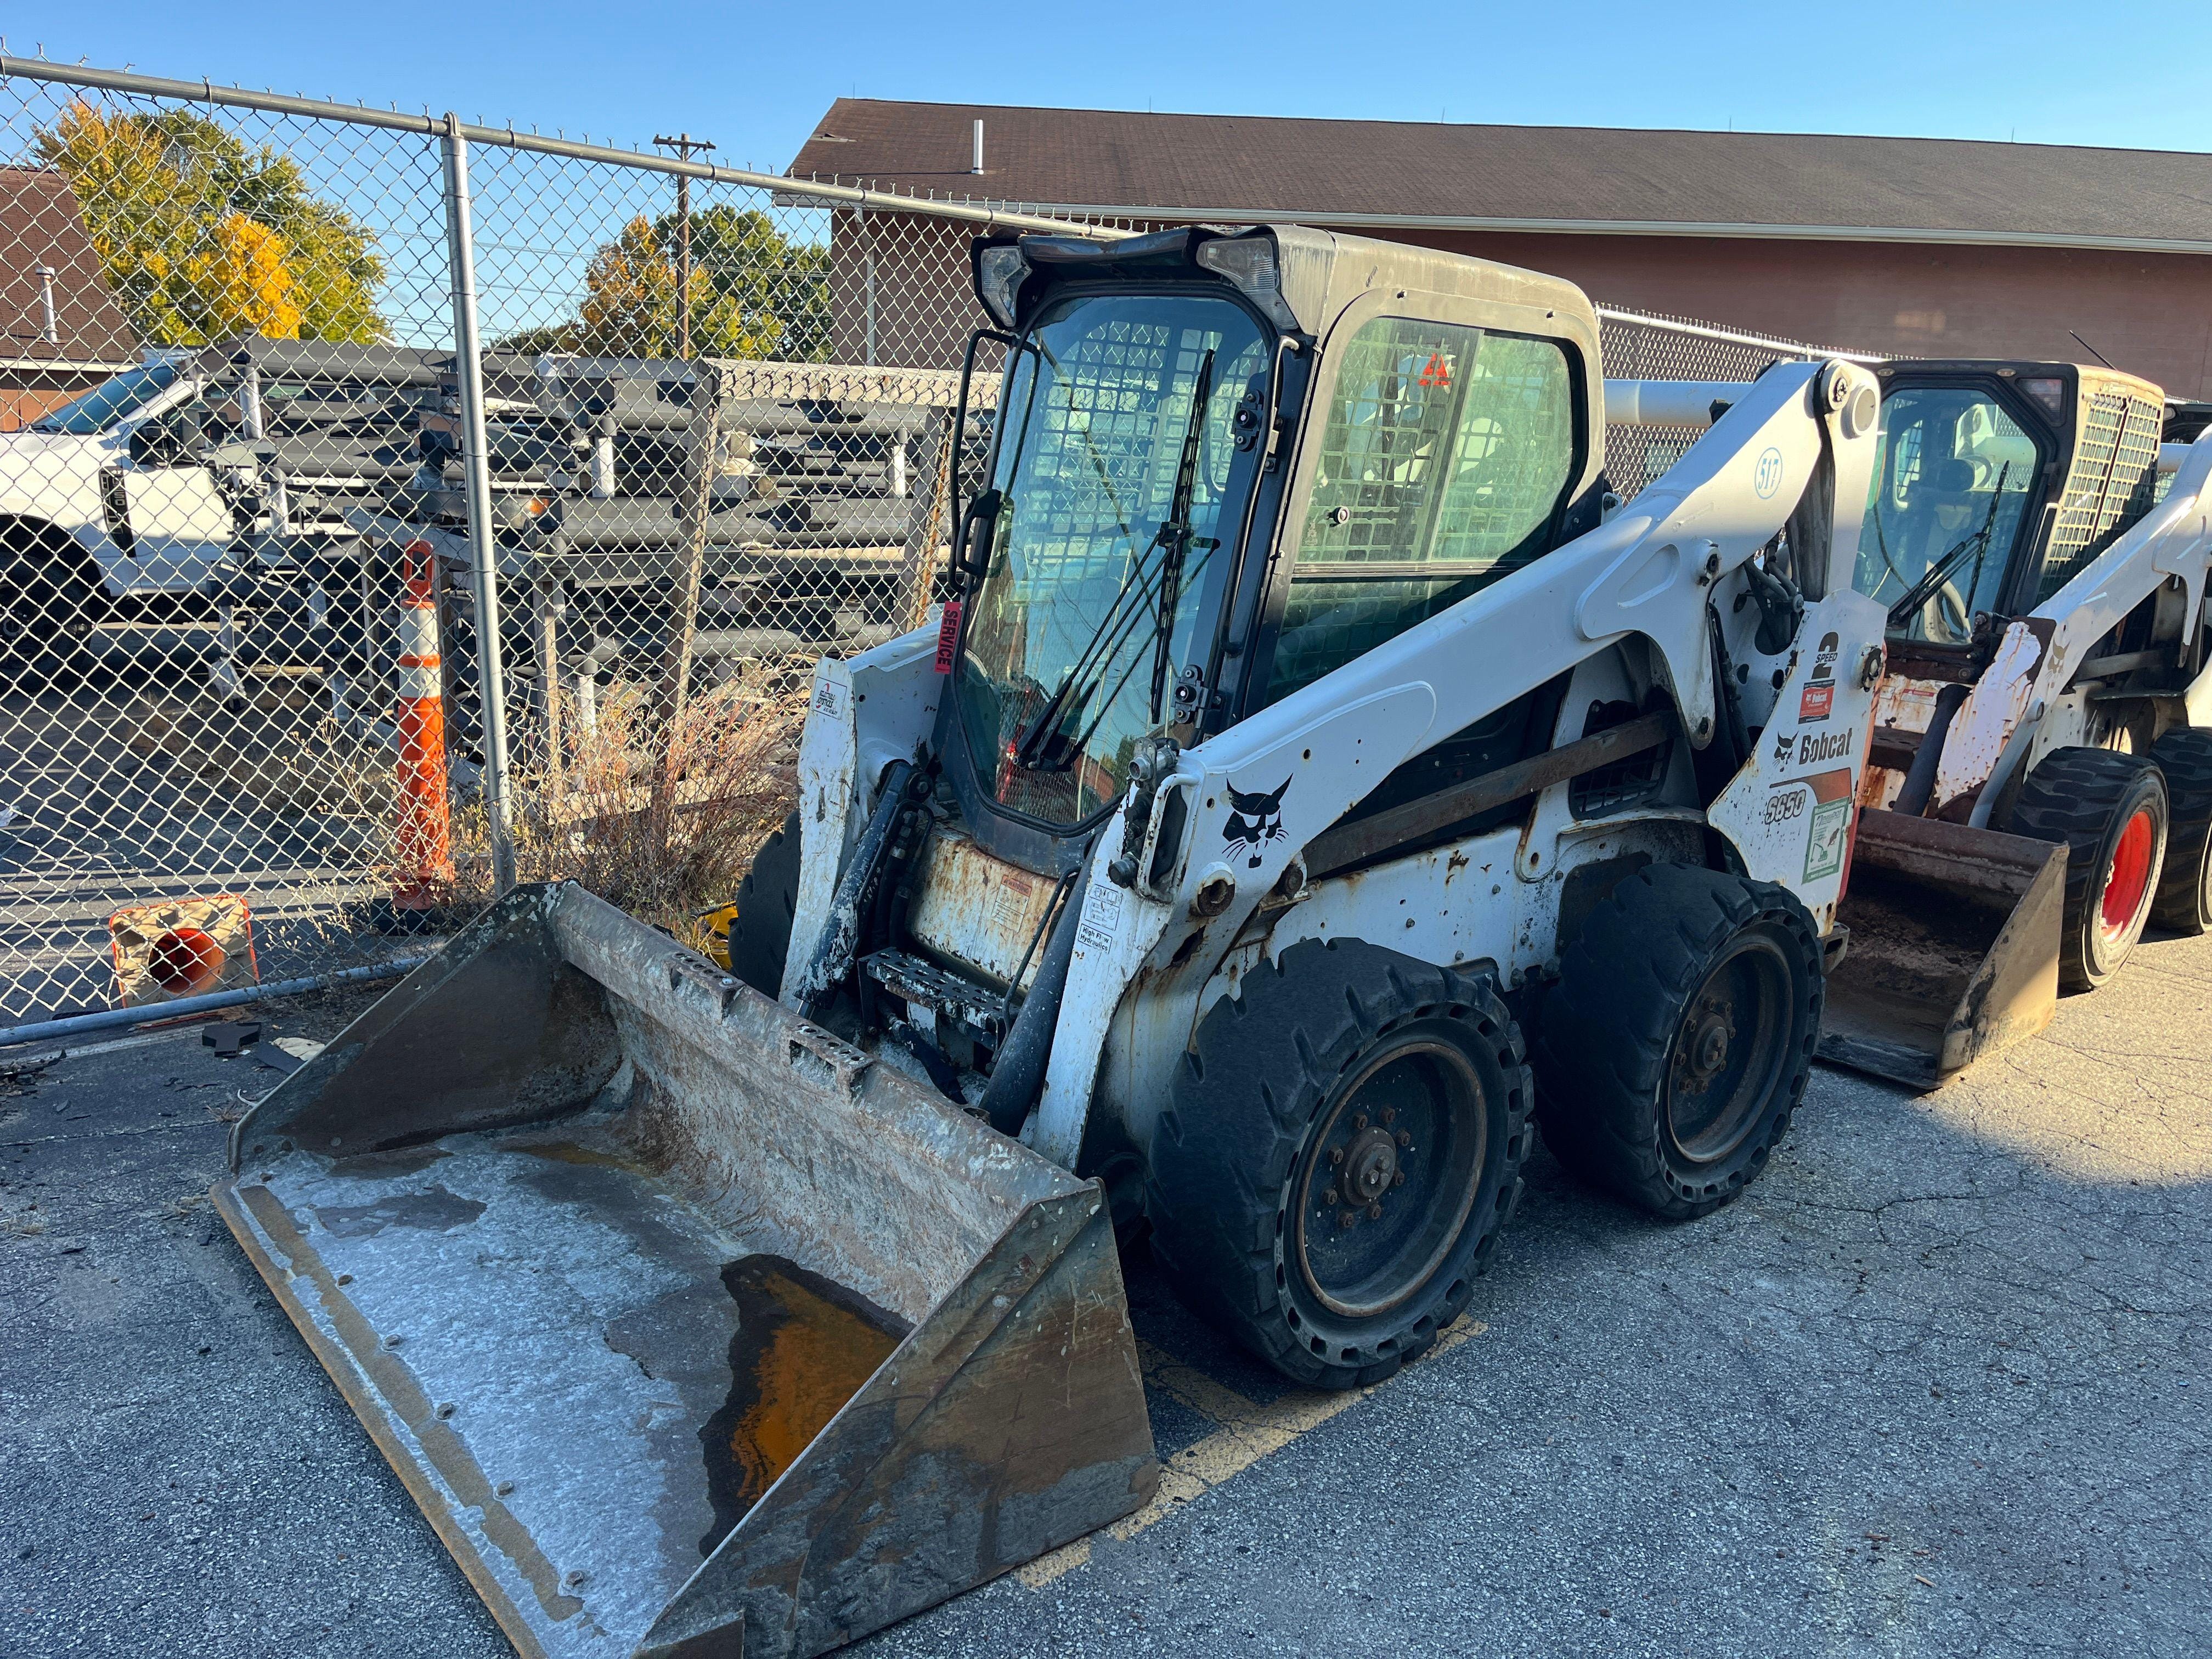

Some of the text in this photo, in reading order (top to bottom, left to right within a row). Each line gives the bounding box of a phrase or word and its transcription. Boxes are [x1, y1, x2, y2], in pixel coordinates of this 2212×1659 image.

[1758, 458, 1779, 489] 517
[938, 610, 958, 665] SERVICE
[1811, 631, 1838, 680] 2
[1815, 652, 1838, 664] SPEED
[1799, 727, 1853, 765] Bobcat
[1764, 789, 1807, 825] S650
[1080, 934, 1108, 951] Hydraulics
[1083, 926, 1109, 943] High Flw
